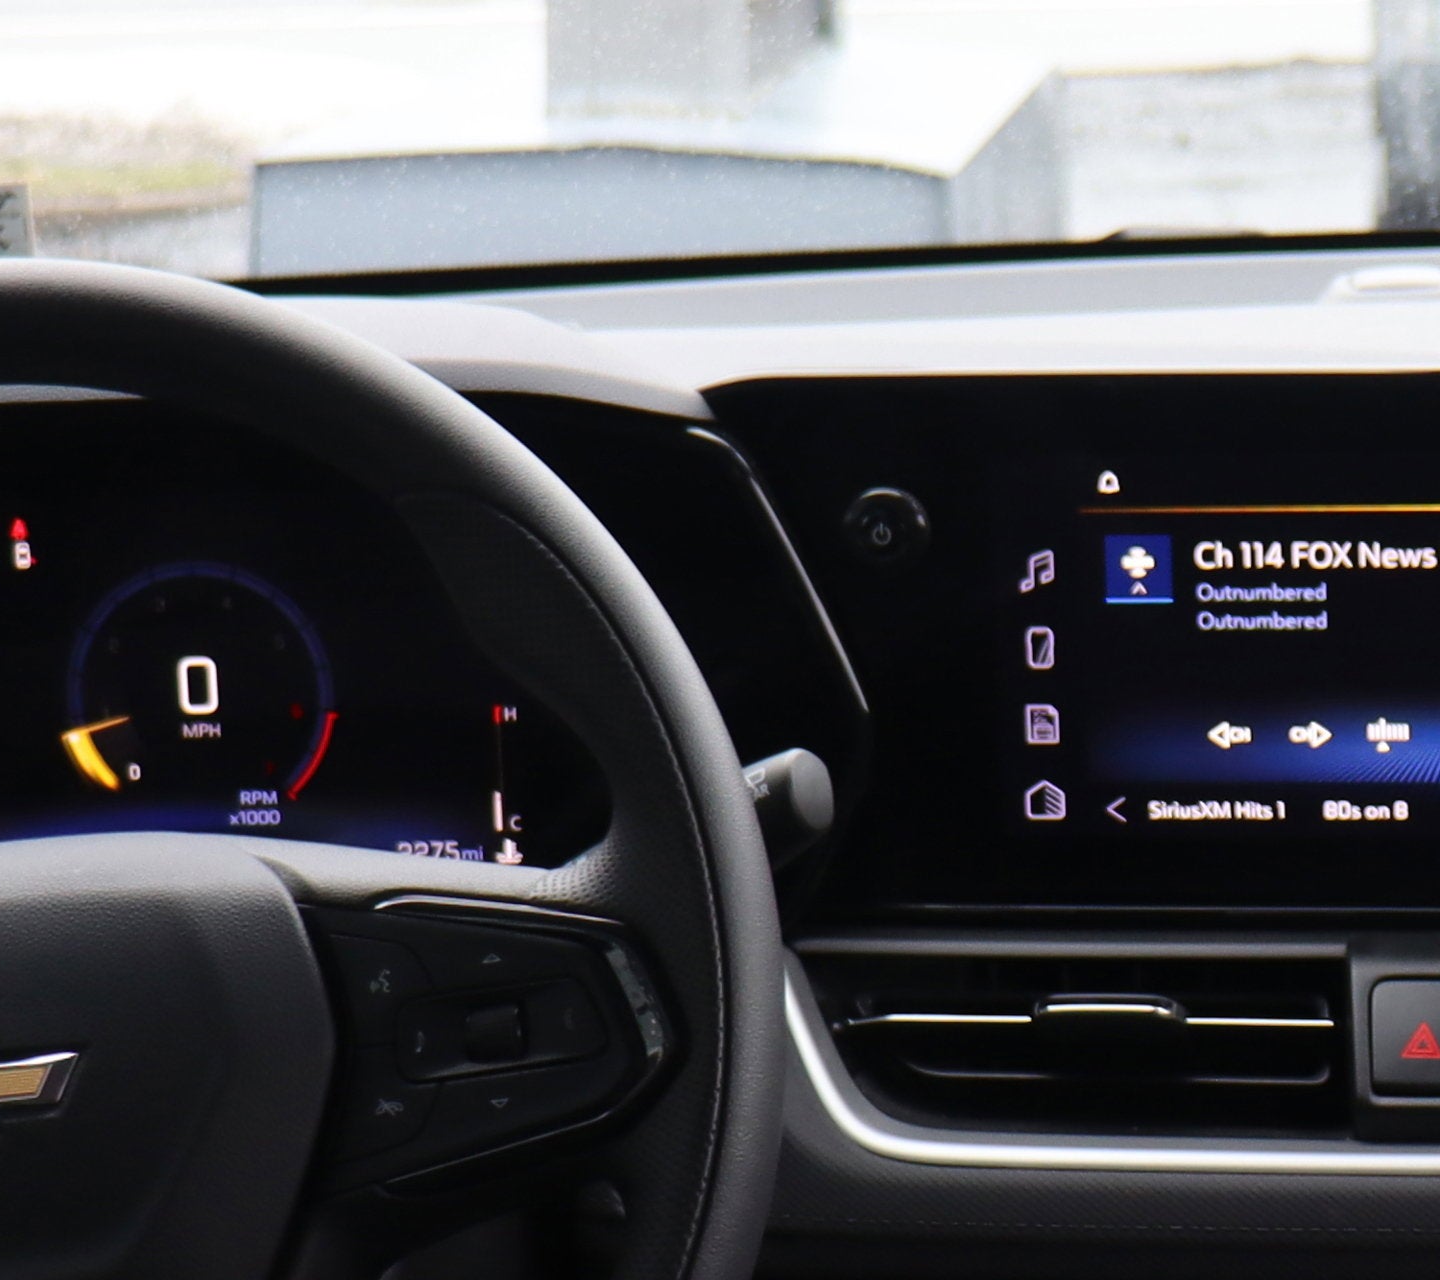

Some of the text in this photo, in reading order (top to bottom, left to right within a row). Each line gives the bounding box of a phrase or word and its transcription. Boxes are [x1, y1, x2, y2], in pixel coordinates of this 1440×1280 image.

[1193, 541, 1233, 570] Ch
[1240, 541, 1284, 569] 114
[1290, 541, 1353, 569] FOX
[1359, 541, 1437, 569] News
[1195, 582, 1328, 603] Outnumbered
[1196, 610, 1328, 631] Outnumbered
[177, 655, 219, 715] 0
[503, 706, 517, 722] H
[182, 723, 222, 739] MPH
[127, 763, 142, 781] 0
[240, 790, 279, 806] RPM
[230, 809, 281, 826] x1000
[1148, 801, 1285, 820] SiriusXM Hits 1
[1364, 804, 1390, 820] on
[510, 814, 522, 832] C
[461, 846, 483, 861] mi
